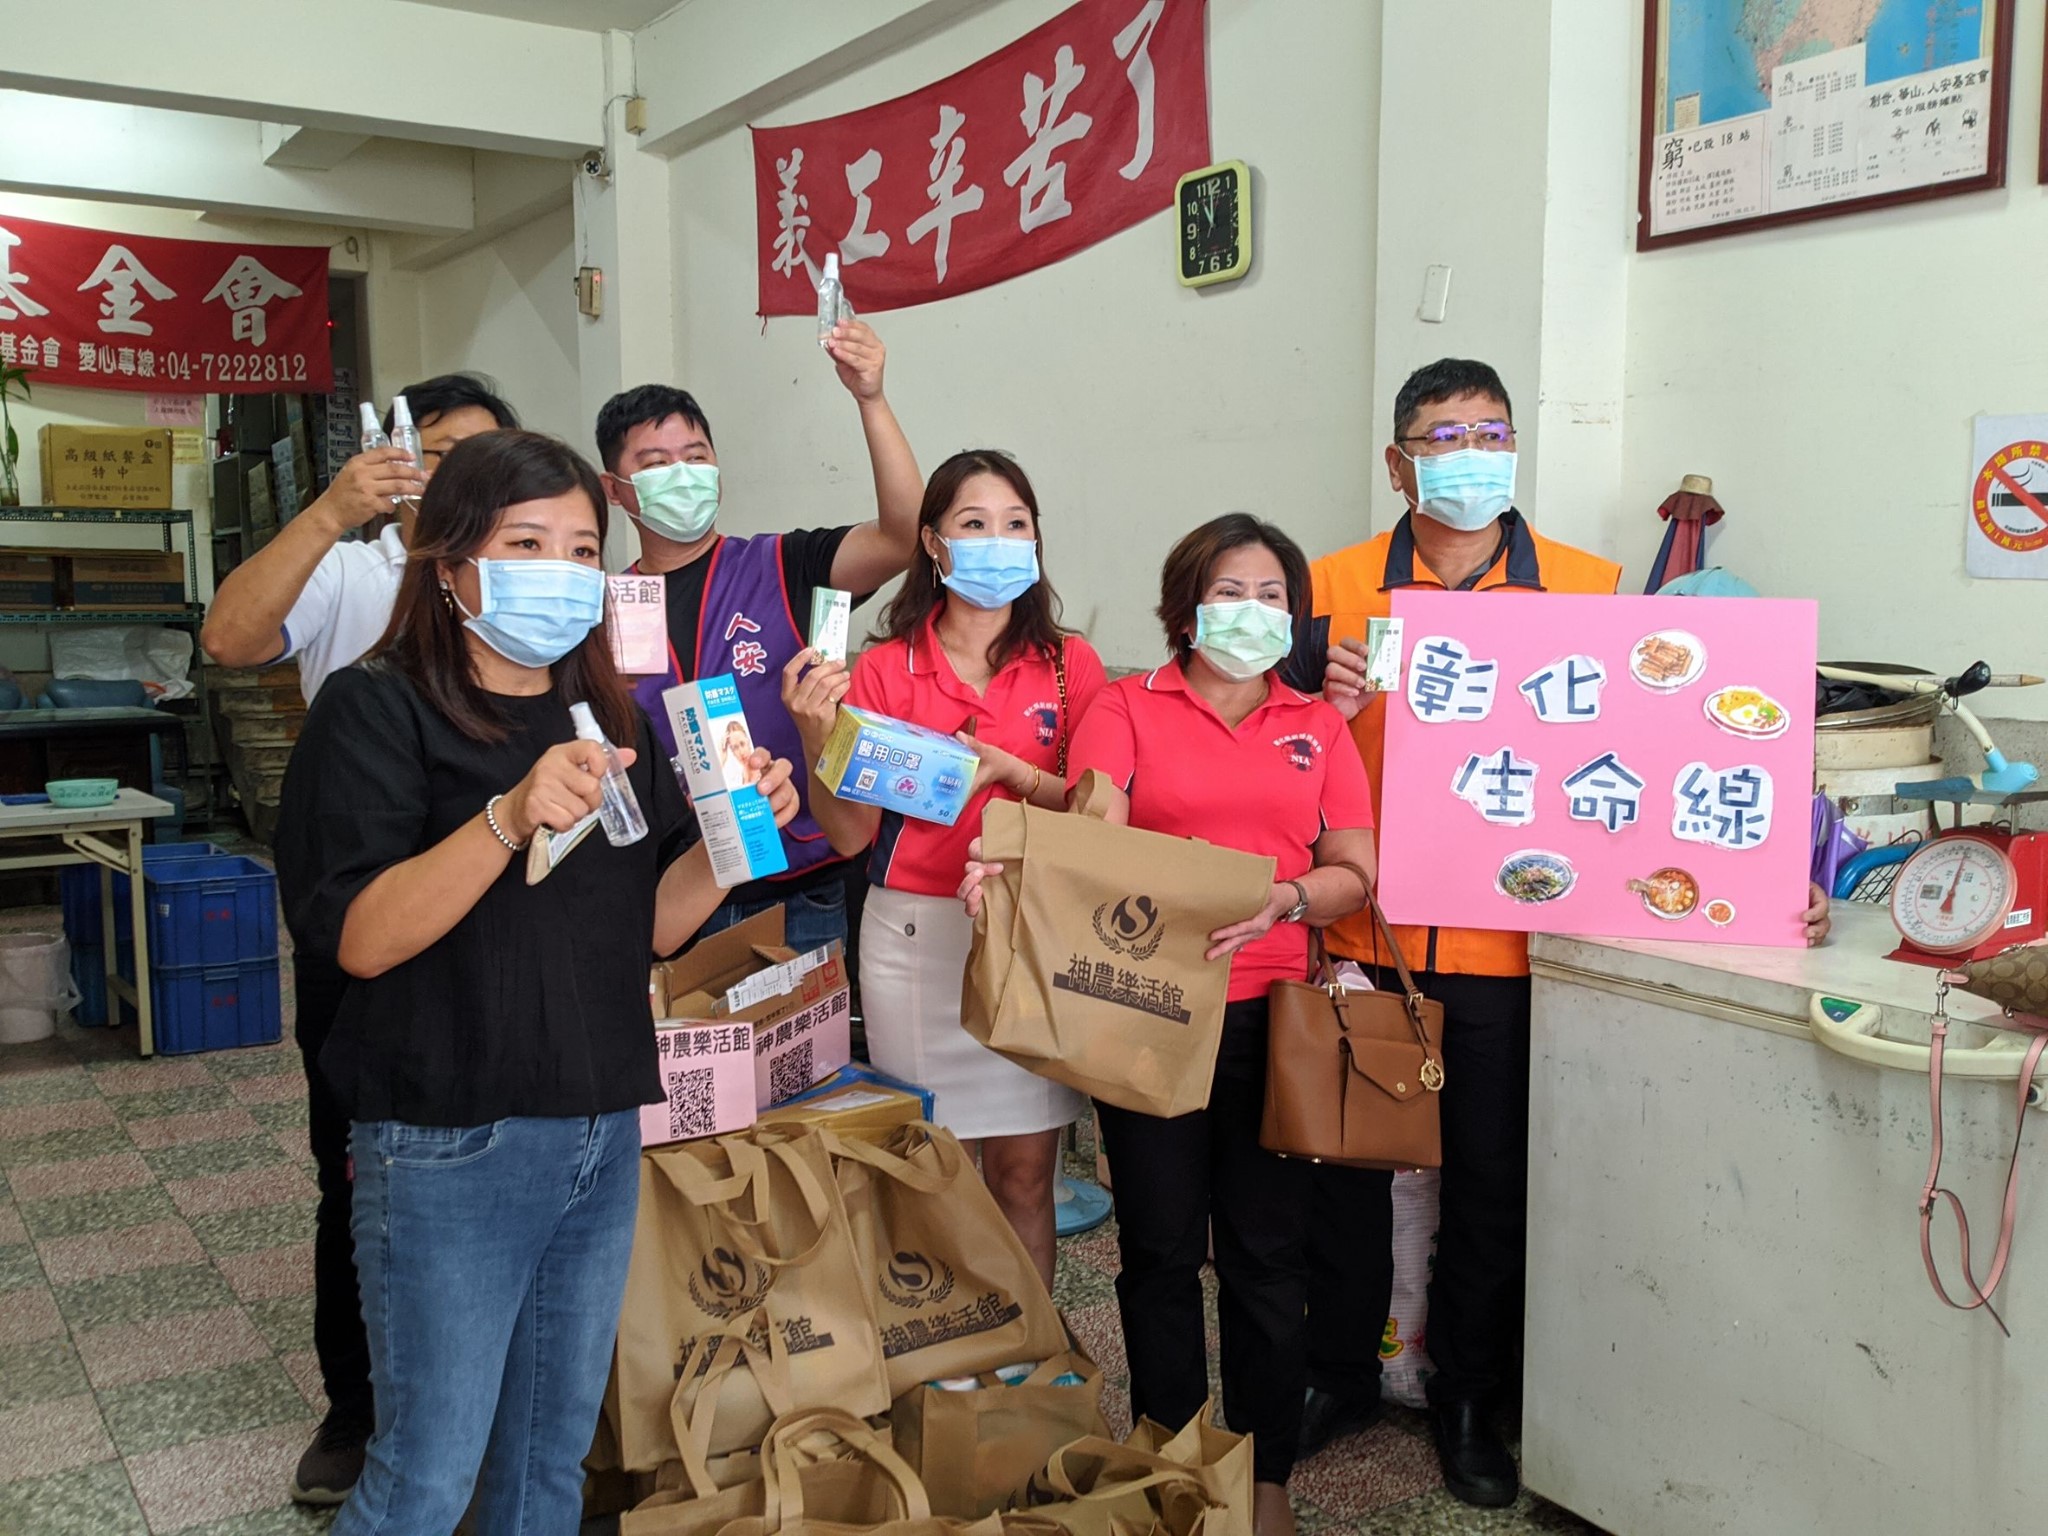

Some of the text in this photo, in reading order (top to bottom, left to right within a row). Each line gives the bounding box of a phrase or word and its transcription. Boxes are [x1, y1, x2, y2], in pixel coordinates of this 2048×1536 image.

[772, 0, 1166, 294] 義工辛苦了
[1662, 138, 1684, 170] 窮
[1197, 183, 1206, 198] 11
[1207, 177, 1220, 195] 12
[1225, 176, 1231, 189] 1
[1187, 201, 1198, 216] 10
[1187, 223, 1197, 240] 9
[1189, 247, 1196, 261] 8
[1226, 253, 1233, 268] 5
[1198, 260, 1205, 274] 7
[1210, 255, 1220, 272] 6
[612, 580, 661, 604] 活館
[725, 612, 767, 677] 人安
[1415, 641, 1602, 716] 彰化
[680, 710, 701, 774] FACE SHIELD
[857, 739, 922, 771] 醫用口罩
[1291, 754, 1310, 766] NIA
[1456, 750, 1766, 844] 生命線
[938, 809, 950, 818] 50
[1067, 953, 1184, 1018] 神農樂活館
[755, 990, 848, 1057] 神農樂活館
